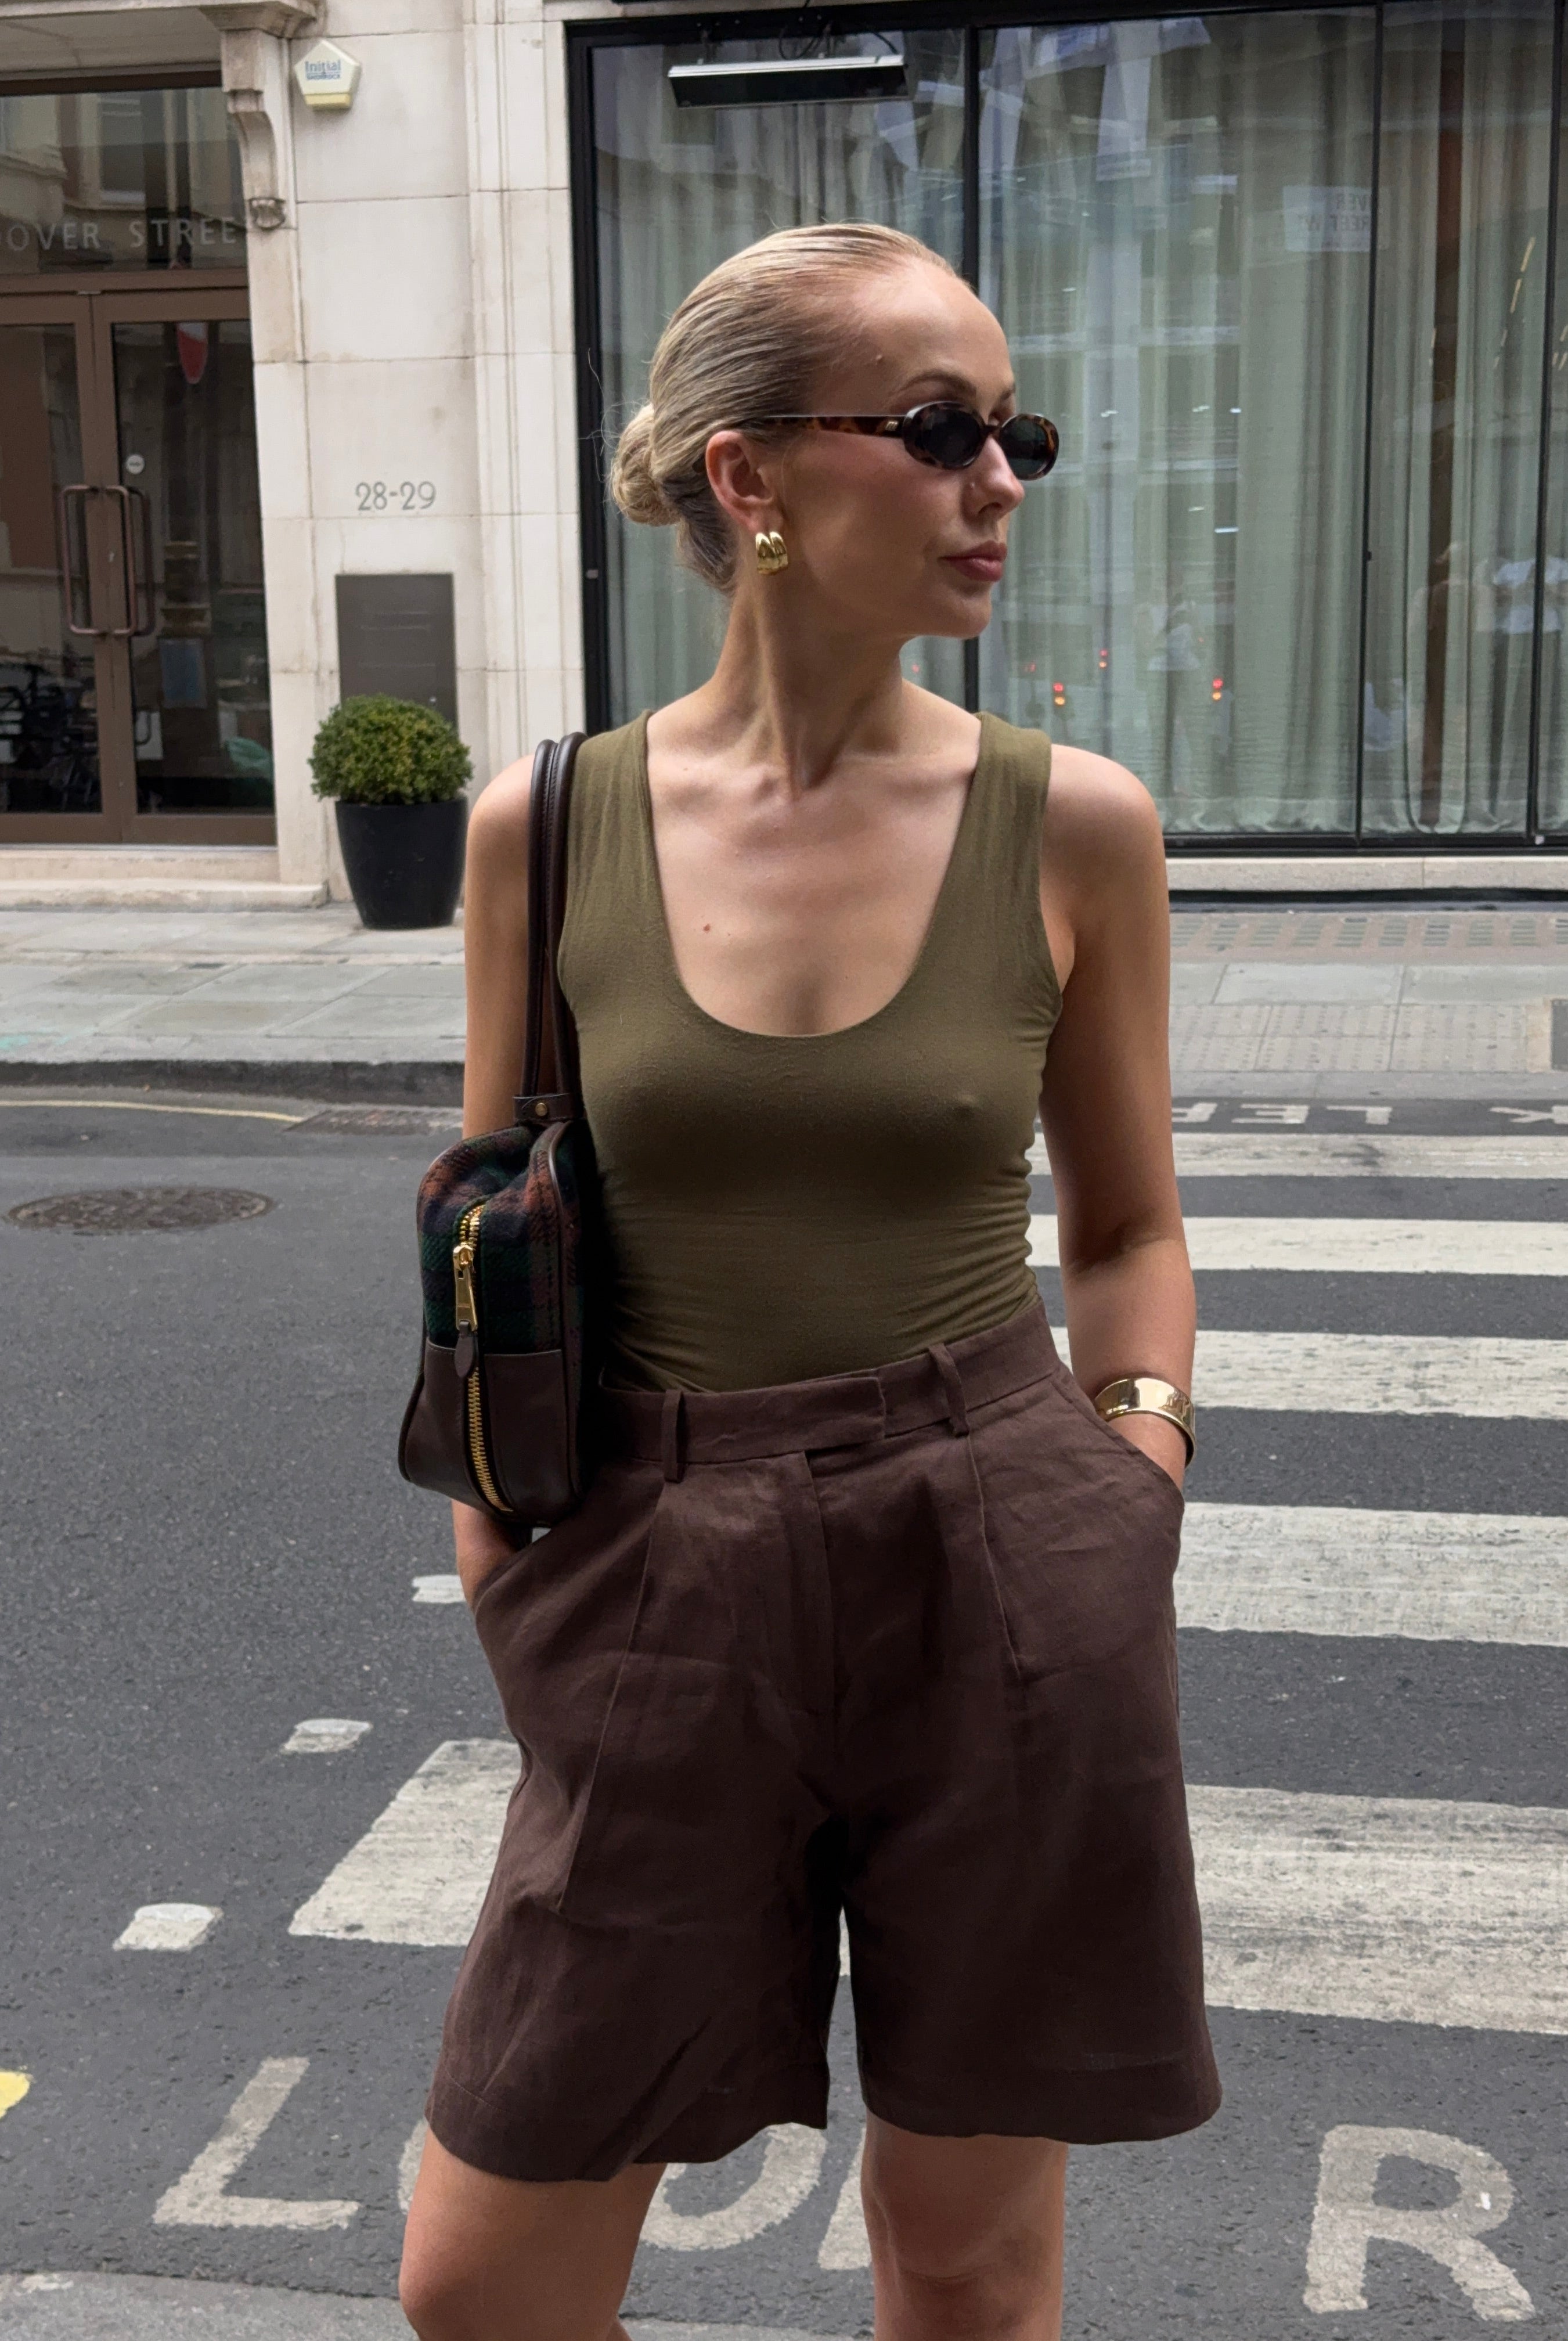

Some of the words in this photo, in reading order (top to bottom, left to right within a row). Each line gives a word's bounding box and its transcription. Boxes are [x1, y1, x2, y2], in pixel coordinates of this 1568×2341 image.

[305, 59, 341, 73] Initial
[0, 221, 101, 251] OVER
[355, 481, 437, 510] 28-29
[1304, 2124, 1534, 2321] R
